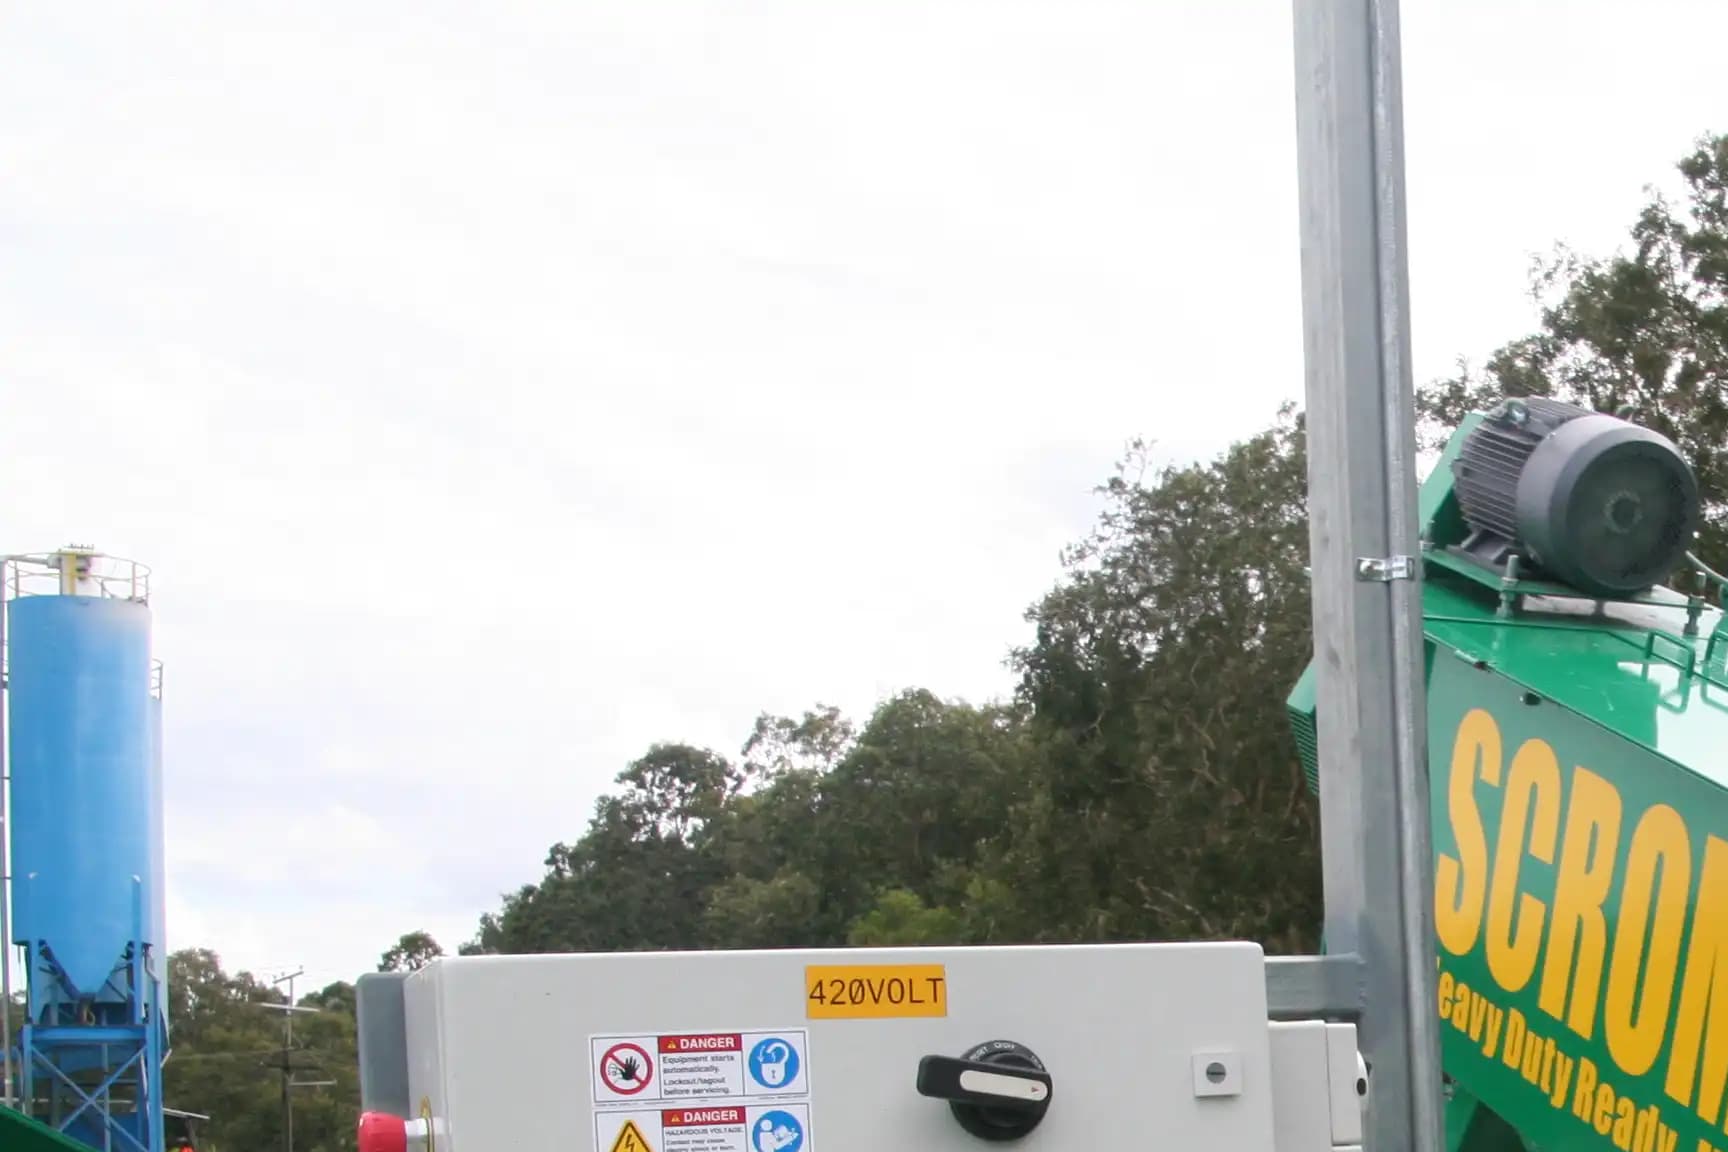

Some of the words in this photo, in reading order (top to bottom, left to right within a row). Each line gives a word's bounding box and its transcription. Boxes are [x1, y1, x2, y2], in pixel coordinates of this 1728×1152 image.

[809, 978, 944, 1005] 420VOLT
[1436, 956, 1503, 1058] eavy
[1502, 1007, 1573, 1109] Duty
[680, 1037, 735, 1049] DANGER
[684, 1110, 738, 1122] DANGER
